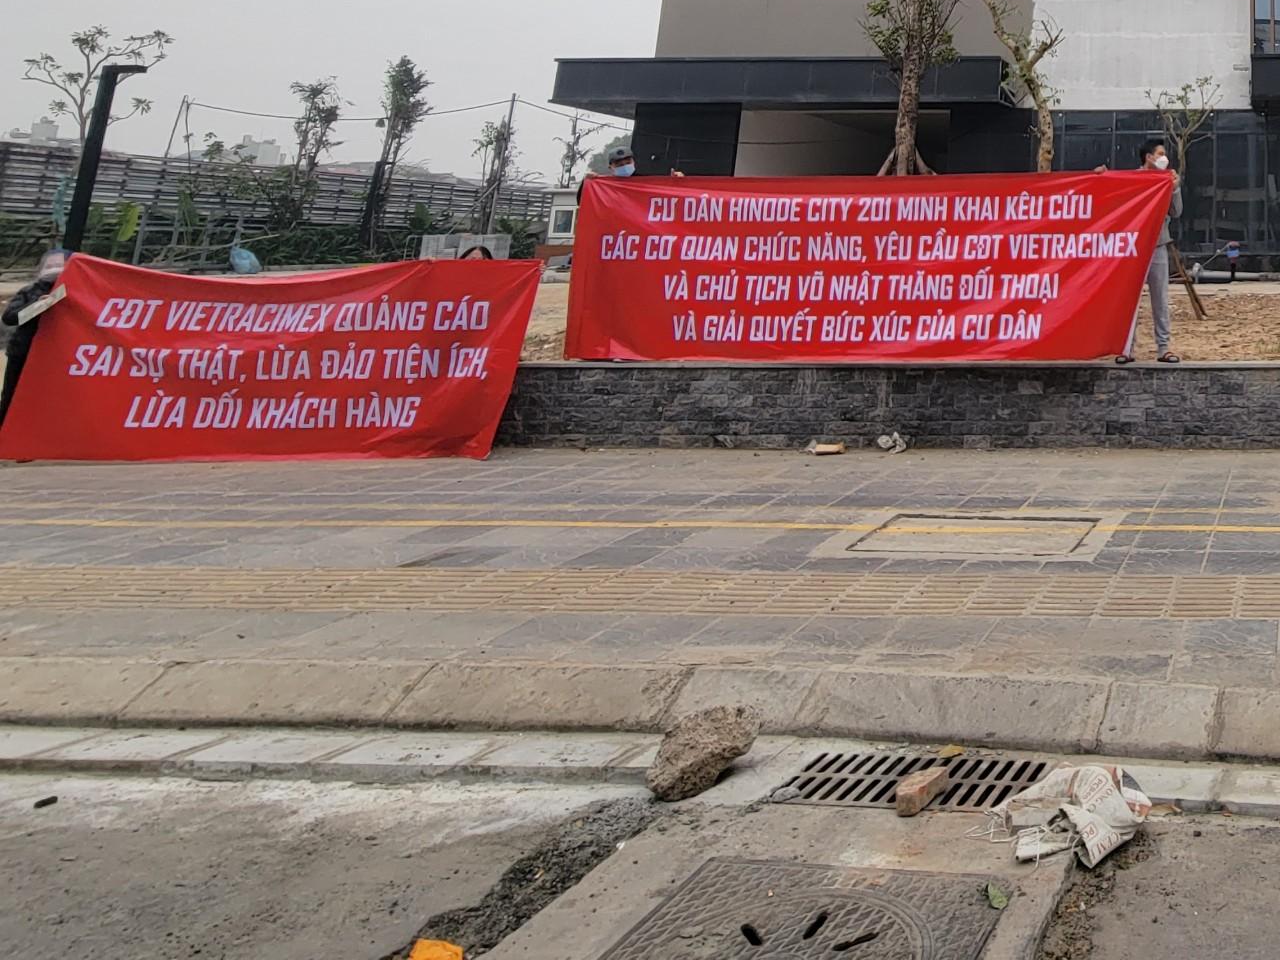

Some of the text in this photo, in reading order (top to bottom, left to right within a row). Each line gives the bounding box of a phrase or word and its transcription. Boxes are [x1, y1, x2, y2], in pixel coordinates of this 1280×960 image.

[648, 190, 1092, 222] CƯ DÂN HINODE CITY 201 MINH KHAI KÊU CỨU
[601, 229, 1138, 262] CÁC CƠ QUAN CHỨC NĂNG, YÊU CẦU CĐT VIETRACIMEX
[665, 269, 1059, 305] VÀ CHỦ TỊCH VÕ NHẬT THĂNG ĐỐI THOẠI
[96, 295, 490, 333] CĐT VIETRACIMEX QUẢNG CÁO
[673, 308, 1042, 342] VÀ GIẢI QUYẾT BỨC XÚC CỦA CƯ DÂN
[69, 342, 489, 385] SAI SỰ THẬT, LỪA ĐẢO TIỆN ÍCH,
[124, 388, 422, 429] LỪA DỐI KHÁCH HÀNG
